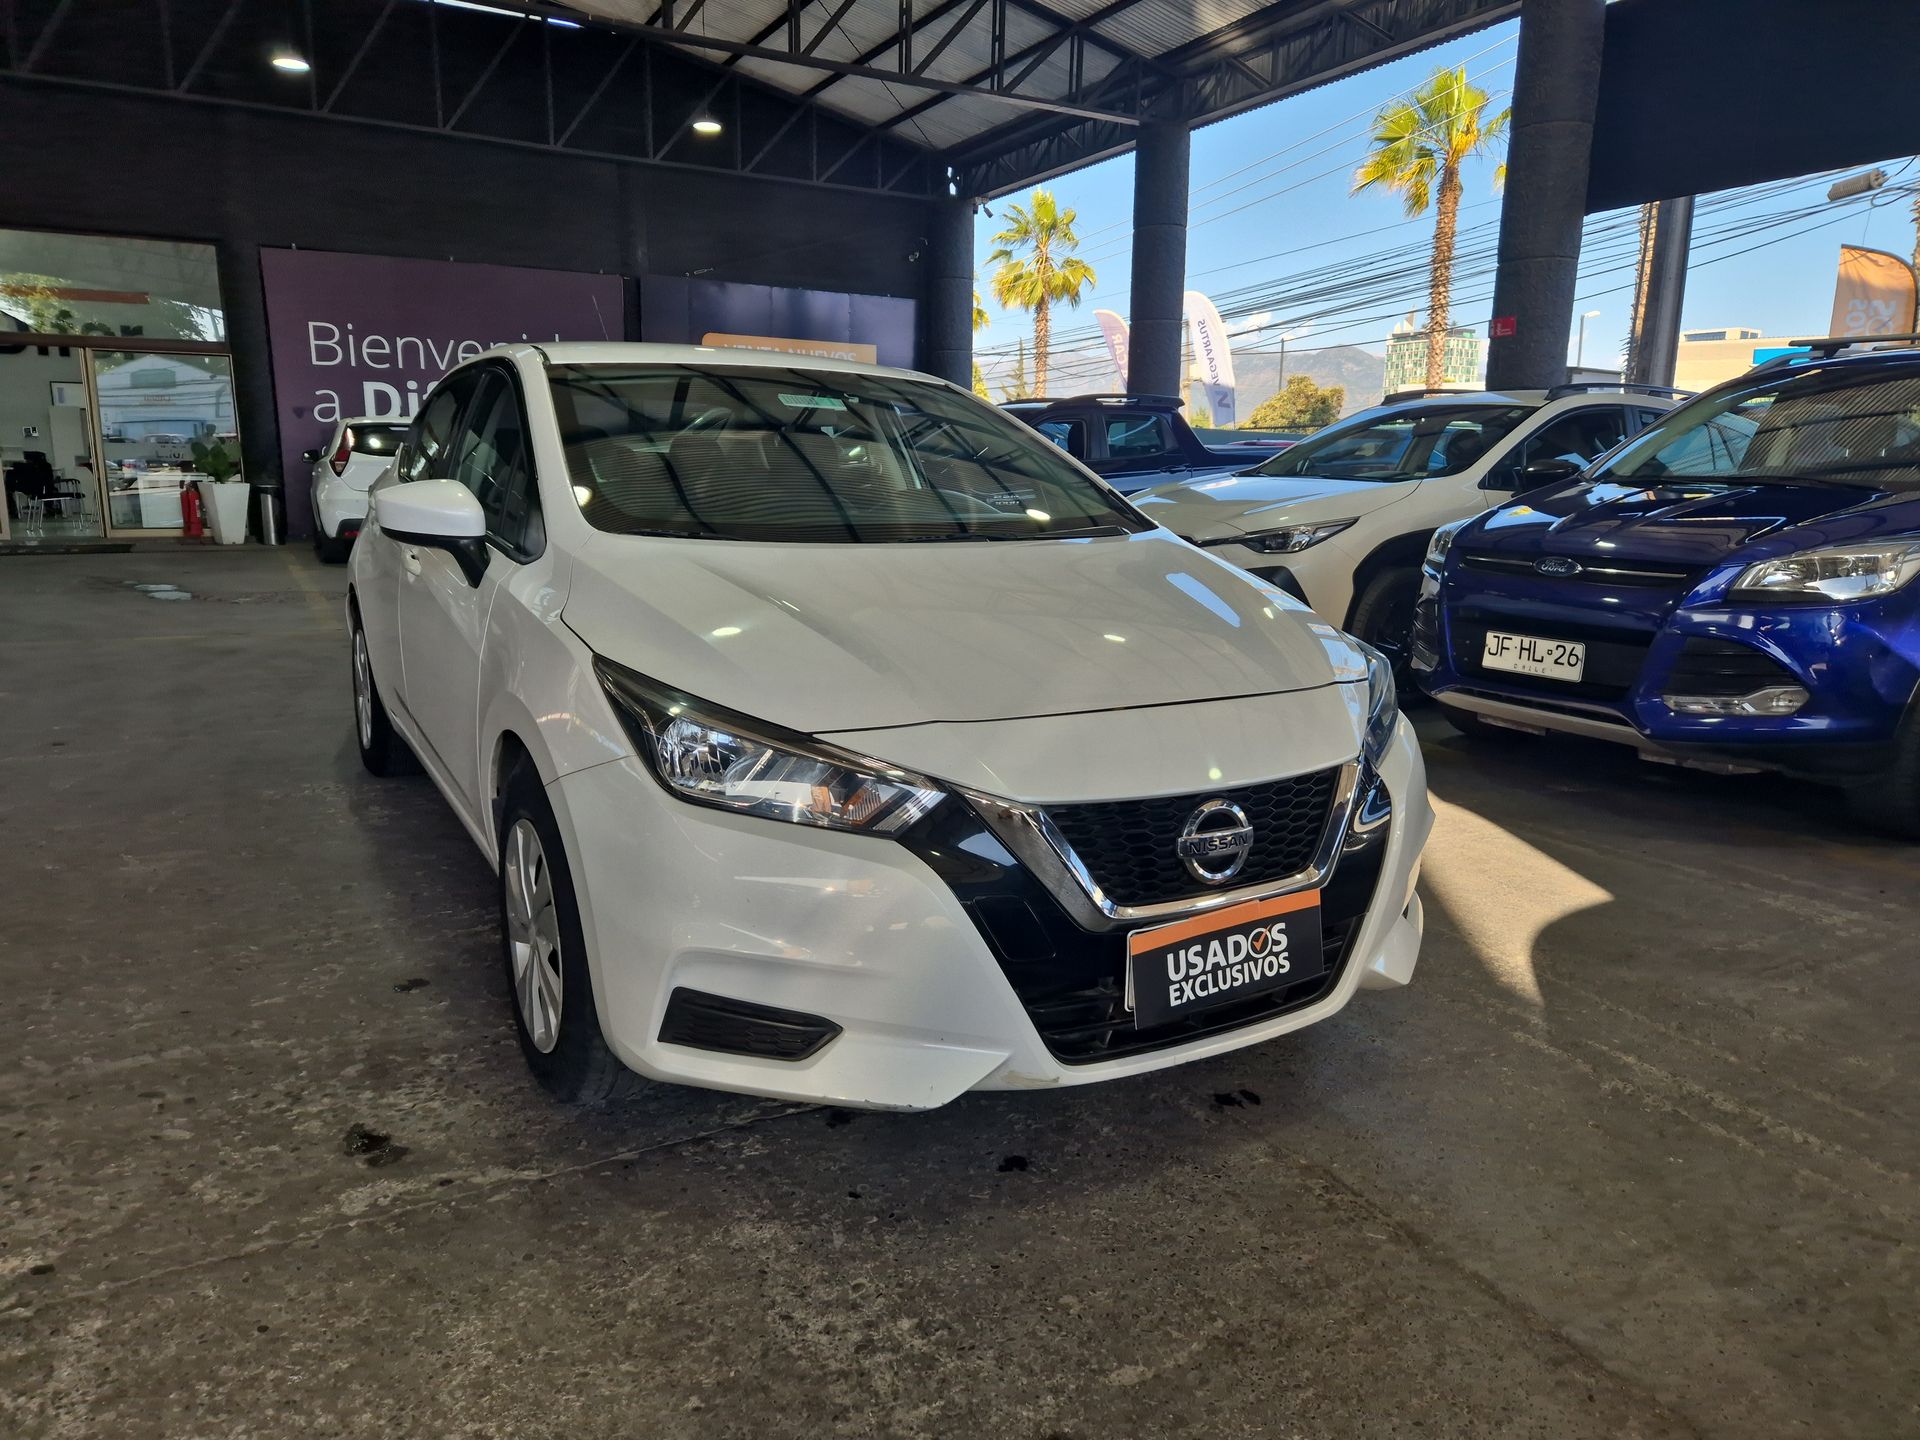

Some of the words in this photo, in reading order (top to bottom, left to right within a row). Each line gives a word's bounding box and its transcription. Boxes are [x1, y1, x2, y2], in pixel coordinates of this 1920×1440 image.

[313, 388, 341, 422] a
[1541, 560, 1569, 573] Ford
[1189, 832, 1248, 855] NISSAN
[1167, 922, 1288, 982] USADOS
[1169, 951, 1291, 1007] EXCLUSIVOS
